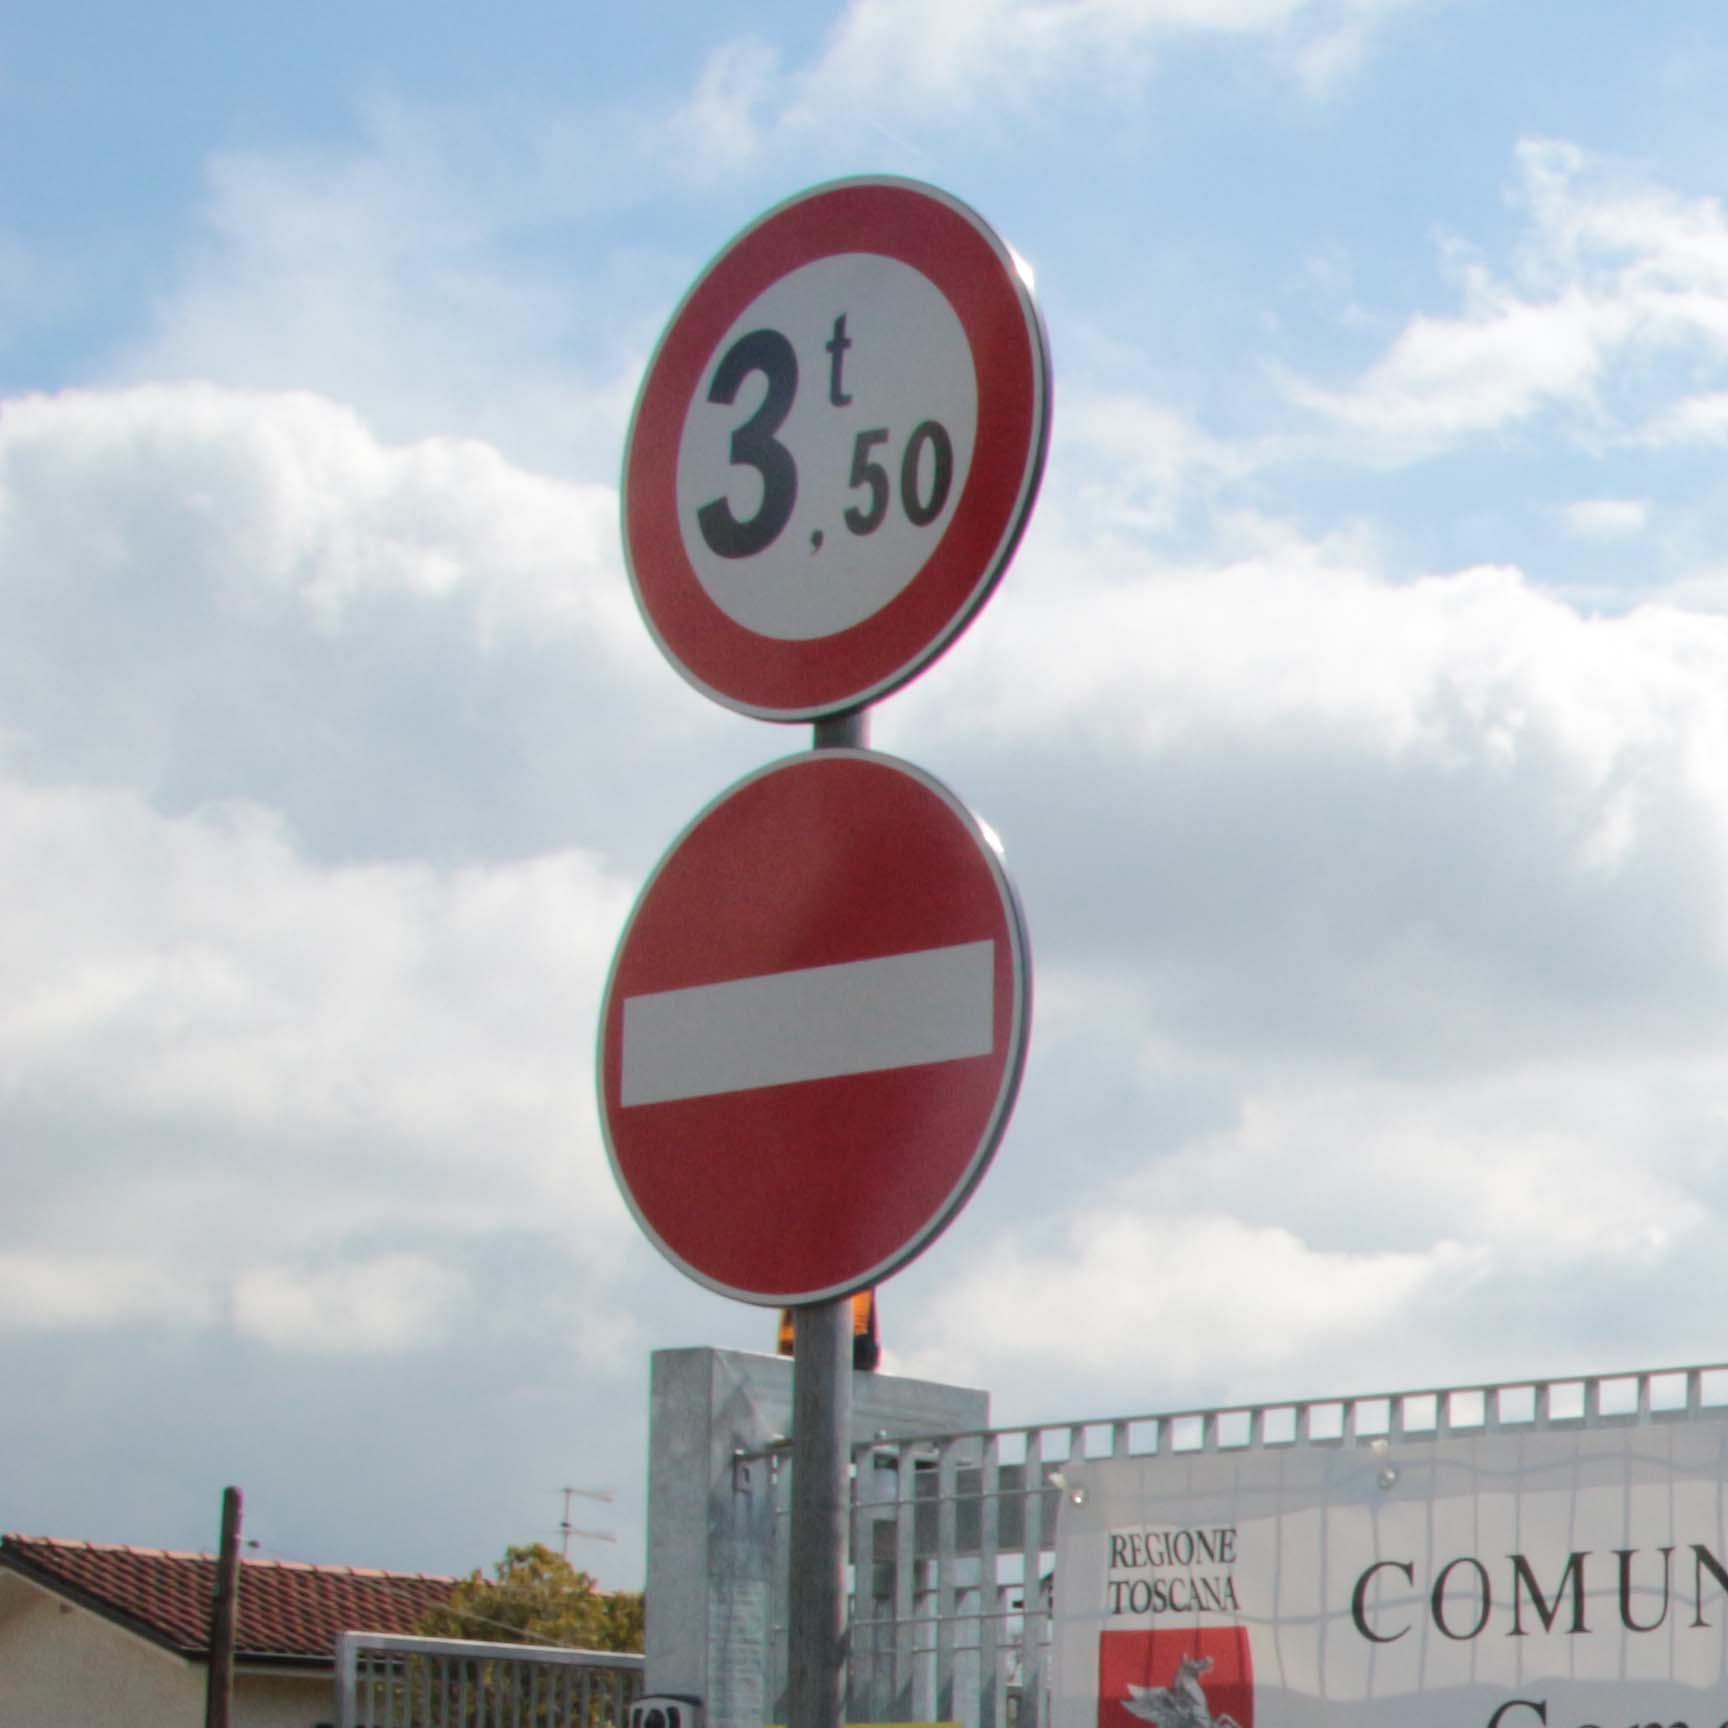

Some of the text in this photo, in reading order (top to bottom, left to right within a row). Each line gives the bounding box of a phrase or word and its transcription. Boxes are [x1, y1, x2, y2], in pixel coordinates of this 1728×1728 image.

[824, 314, 853, 407] t
[1110, 1528, 1238, 1569] REGIONE
[1109, 1575, 1240, 1616] TOSCANA
